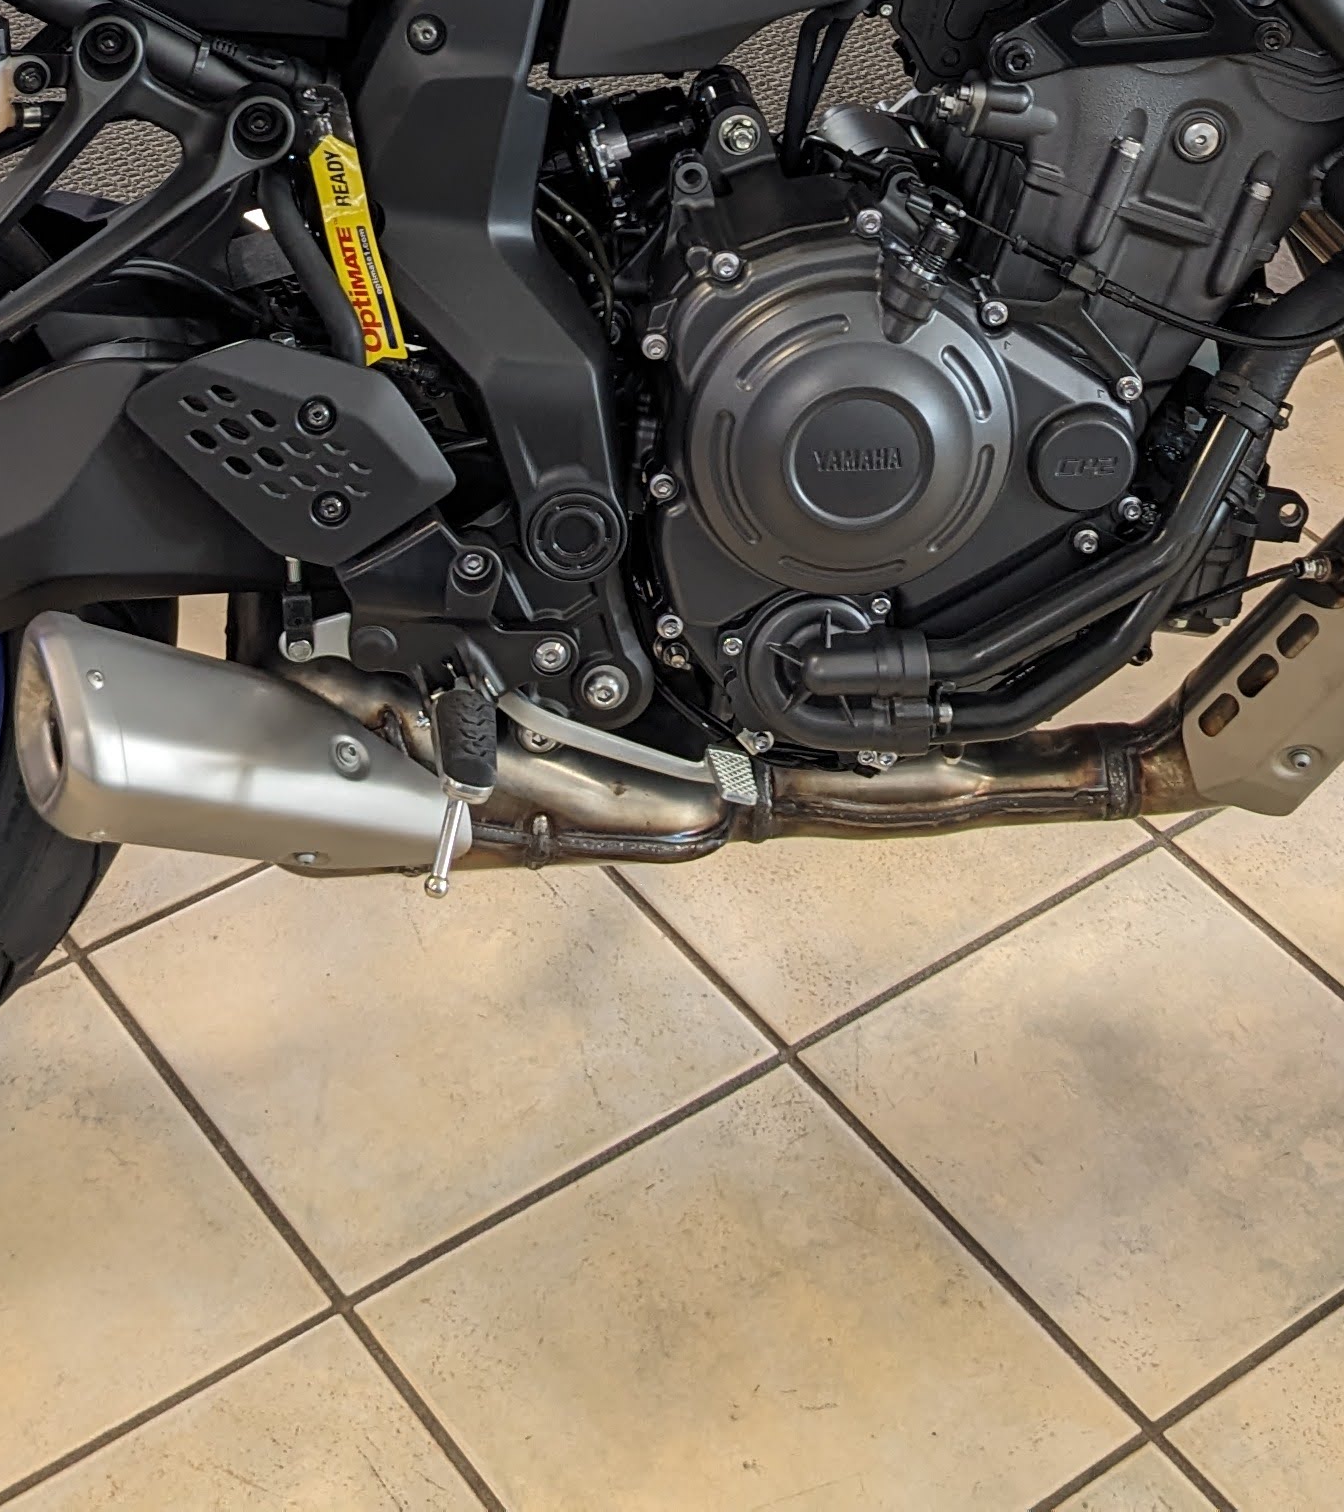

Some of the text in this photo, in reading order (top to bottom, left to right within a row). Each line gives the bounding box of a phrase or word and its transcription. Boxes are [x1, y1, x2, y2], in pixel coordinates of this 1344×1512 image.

[323, 150, 352, 207] READY
[358, 228, 384, 295] optimate1.com
[812, 446, 903, 473] YAMAHA
